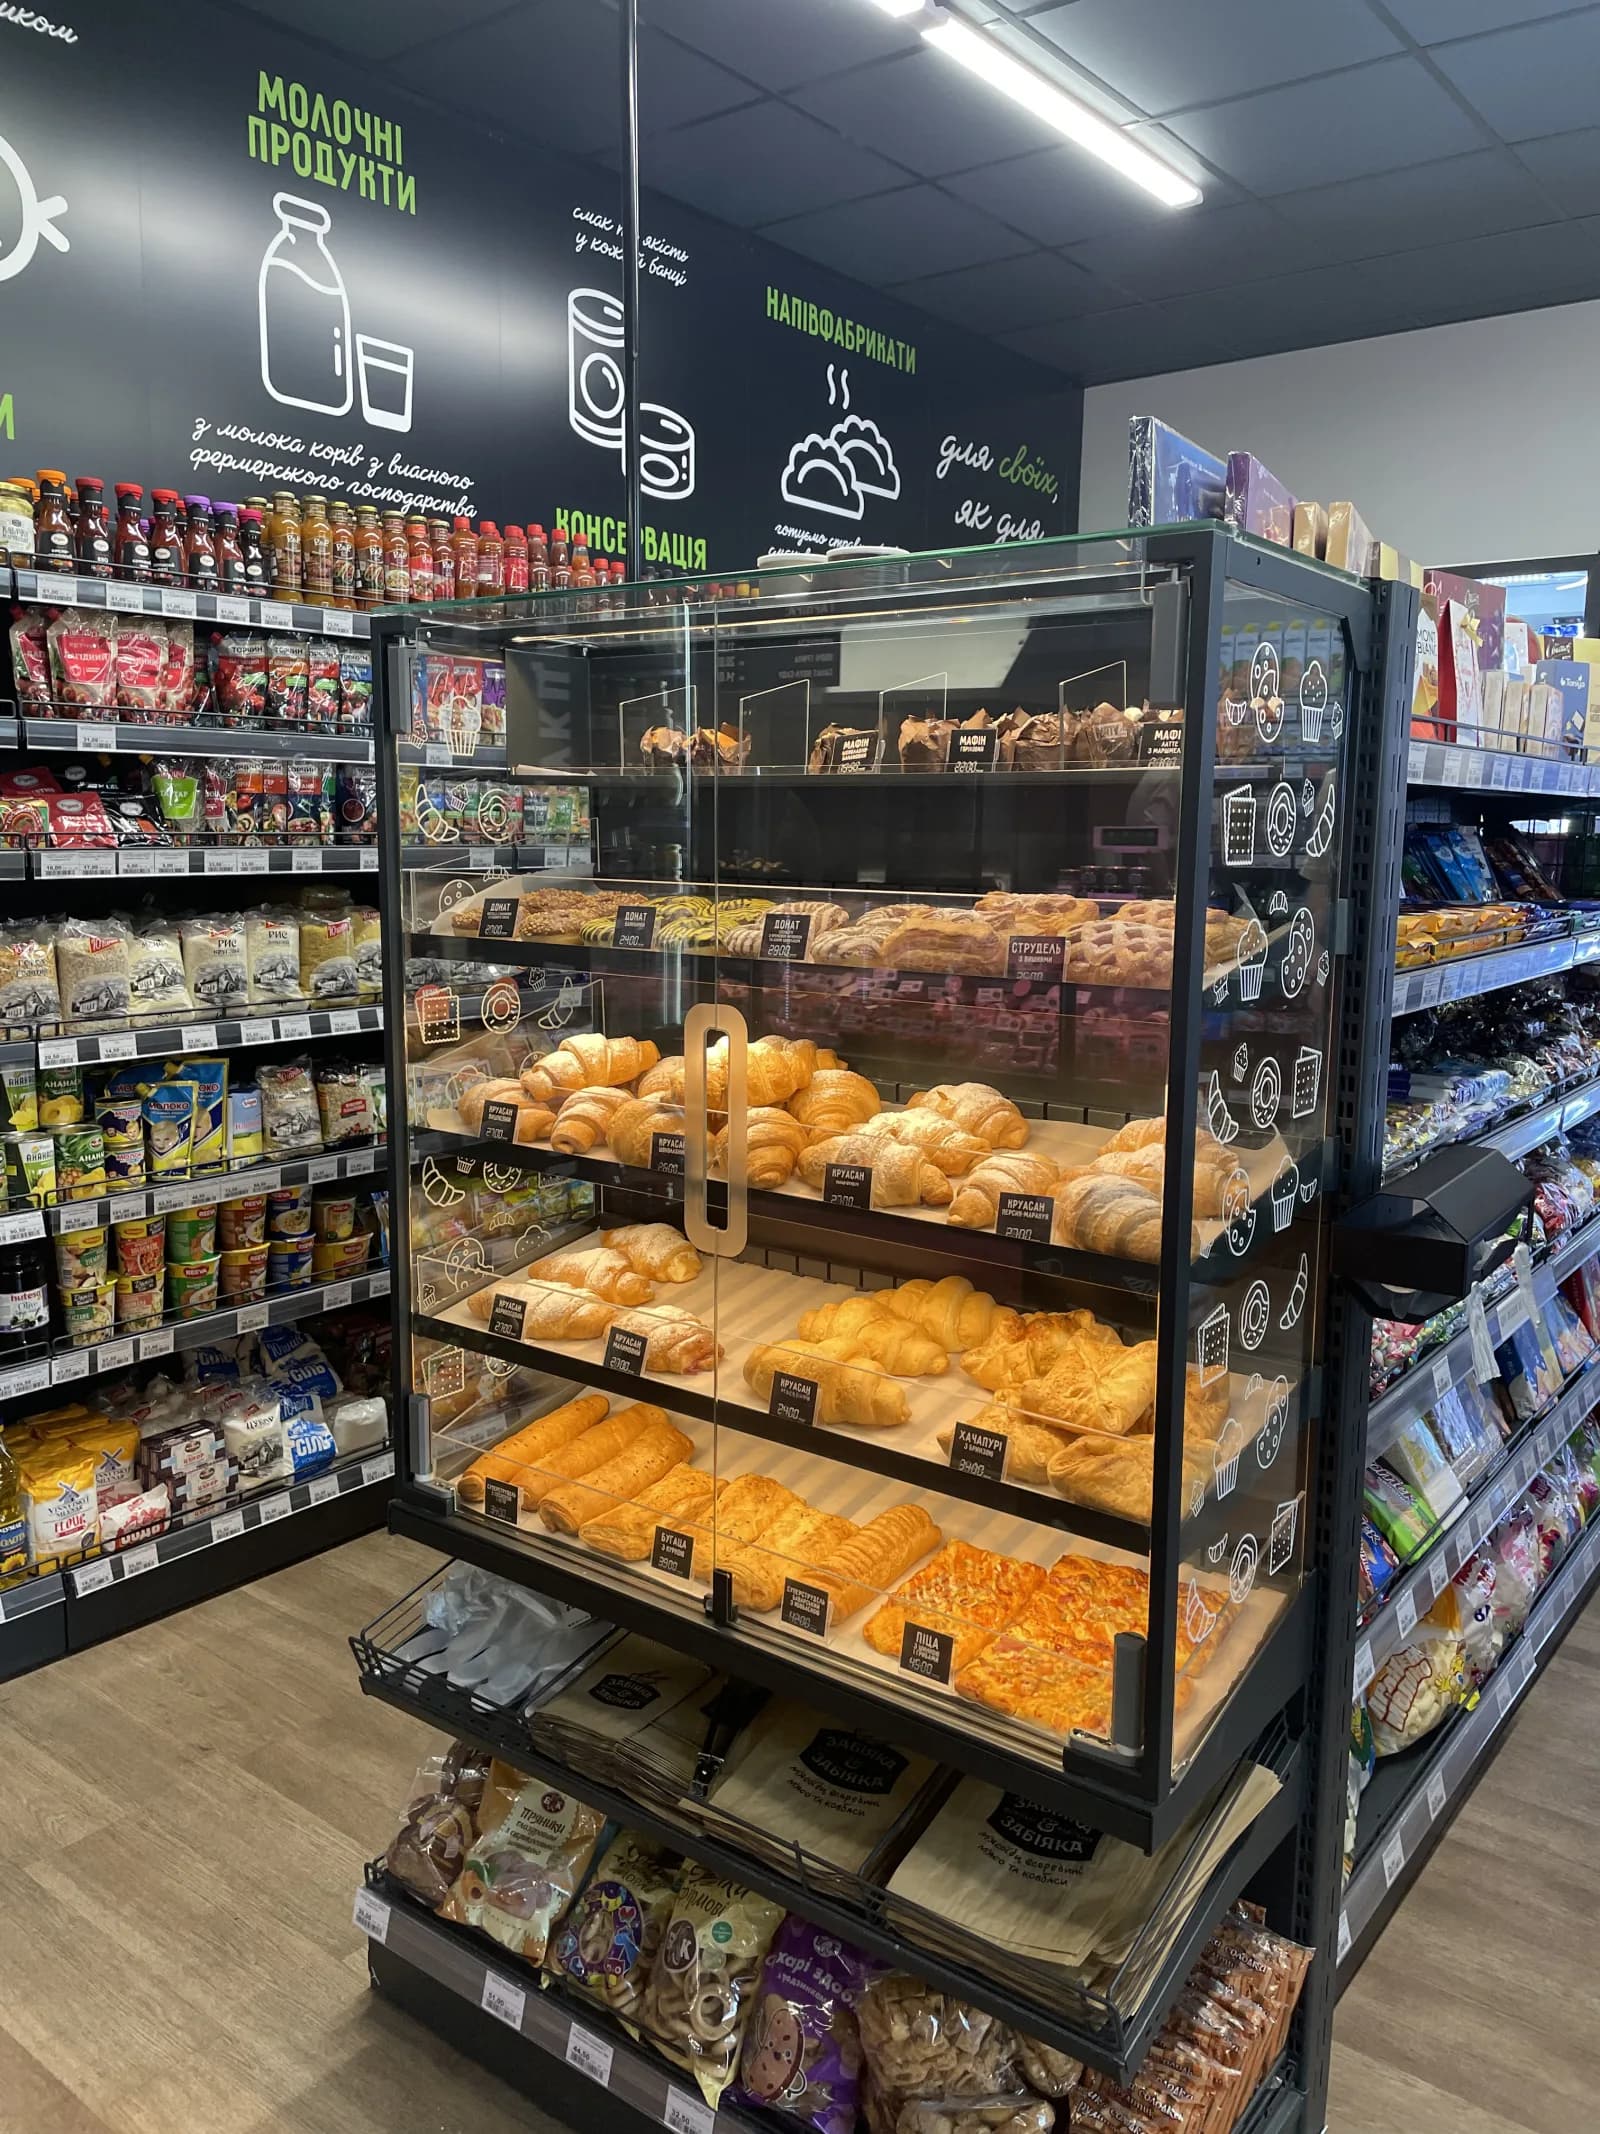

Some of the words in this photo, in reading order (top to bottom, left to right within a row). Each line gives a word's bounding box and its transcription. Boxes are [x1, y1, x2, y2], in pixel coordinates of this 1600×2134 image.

[257, 70, 403, 165] МОЛОЧНІ
[248, 115, 417, 215] ПРОДУКТИ
[572, 207, 614, 231] смак
[642, 235, 689, 262] якість
[575, 232, 588, 253] у
[649, 256, 688, 287] банці
[766, 286, 917, 375] НАПІВФАБРИКАТИ
[192, 417, 211, 441] з
[217, 421, 306, 453] молока
[309, 442, 365, 467] корів
[367, 456, 384, 478] з
[387, 452, 475, 490] власного
[936, 434, 994, 480] для
[190, 446, 345, 491] фермерського
[346, 478, 478, 519] господарства
[954, 499, 993, 531] як
[995, 513, 1045, 544] для
[556, 507, 707, 571] КОНСЕВАЦІЯ
[774, 522, 828, 546] готуємо
[1417, 630, 1437, 643] MONT
[843, 737, 870, 750] МАФІН
[959, 735, 986, 747] МАФІН
[1154, 729, 1182, 741] МАФІ
[490, 903, 512, 912] ДОНАТ
[624, 911, 649, 921] ДОНАТ
[774, 919, 801, 930] ДОНАТ
[217, 939, 238, 948] РИС
[268, 931, 288, 940] РИС
[1011, 941, 1062, 955] СТРУДЕЛЬ
[148, 1101, 189, 1111] МОЛОКО
[488, 1105, 514, 1116] КРУАСАН
[831, 1167, 865, 1181] КРУАСАН
[1007, 1198, 1046, 1212] КРУАСАН
[499, 1300, 522, 1312] КРУАСАН
[615, 1333, 642, 1349] КРУАСАН
[289, 1363, 326, 1382] СІЛЬ
[780, 1377, 811, 1396] КРУАСАН
[296, 1433, 332, 1457] СІЛЬ
[958, 1429, 1003, 1452] ХАЧАПУРІ
[916, 1631, 940, 1650] ПІЦА
[825, 1736, 897, 1769] ЗАБІЯКА
[811, 1751, 884, 1788] ЗАБІЯКА
[520, 1806, 566, 1834] ПРЯНИКИ
[1000, 1815, 1084, 1854] ЗАБІЯКА
